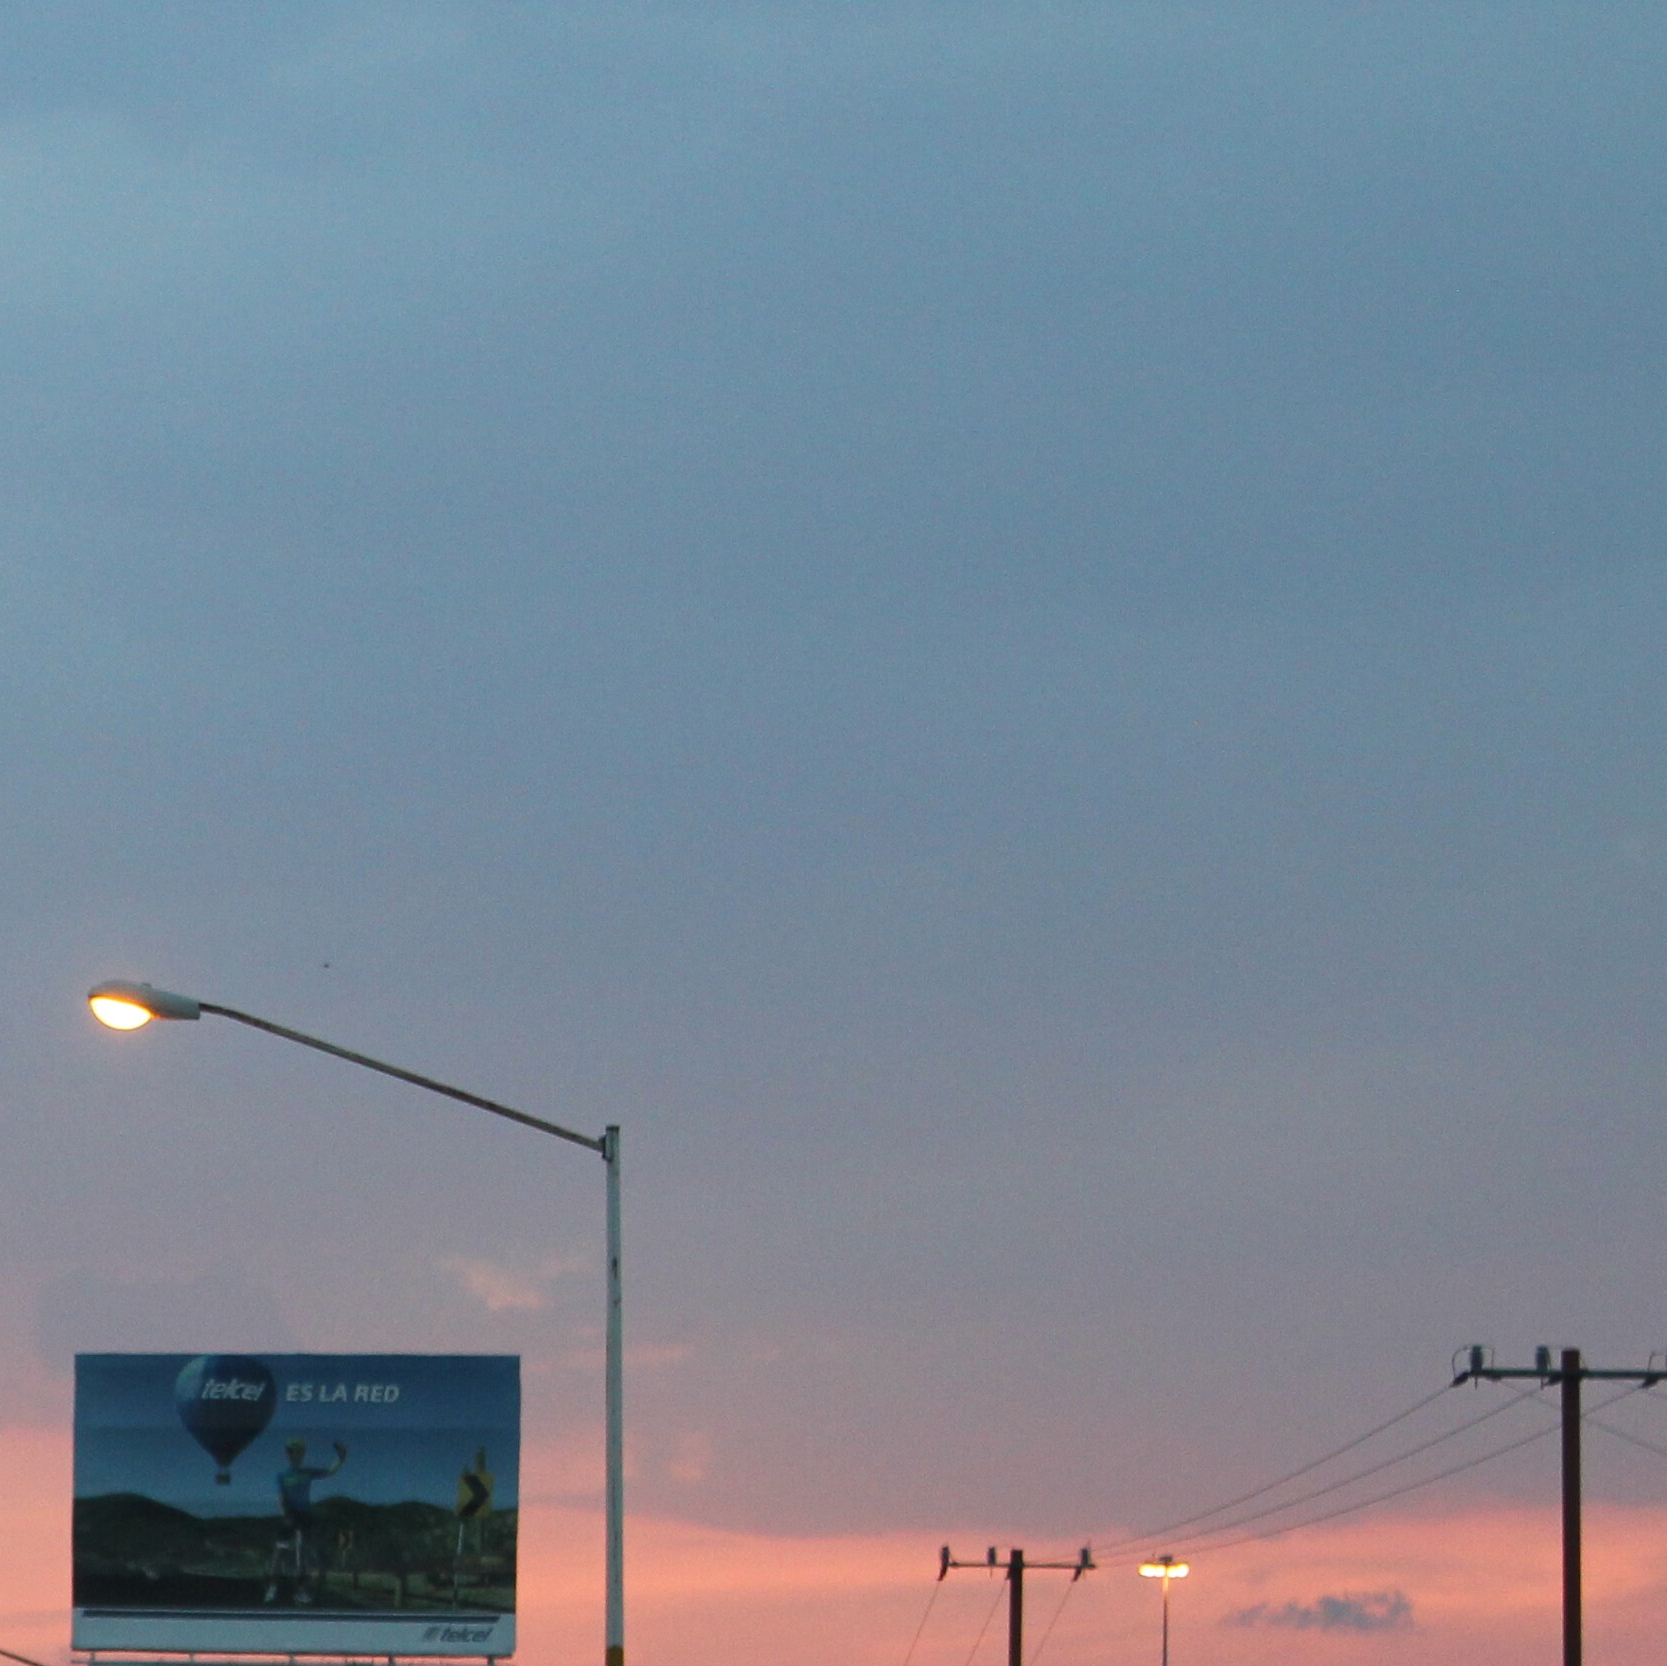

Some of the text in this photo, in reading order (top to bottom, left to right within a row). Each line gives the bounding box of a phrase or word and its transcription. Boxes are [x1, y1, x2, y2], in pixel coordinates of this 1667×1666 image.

[202, 1377, 399, 1403] telcel ES LA RED
[440, 1626, 492, 1643] telcel
